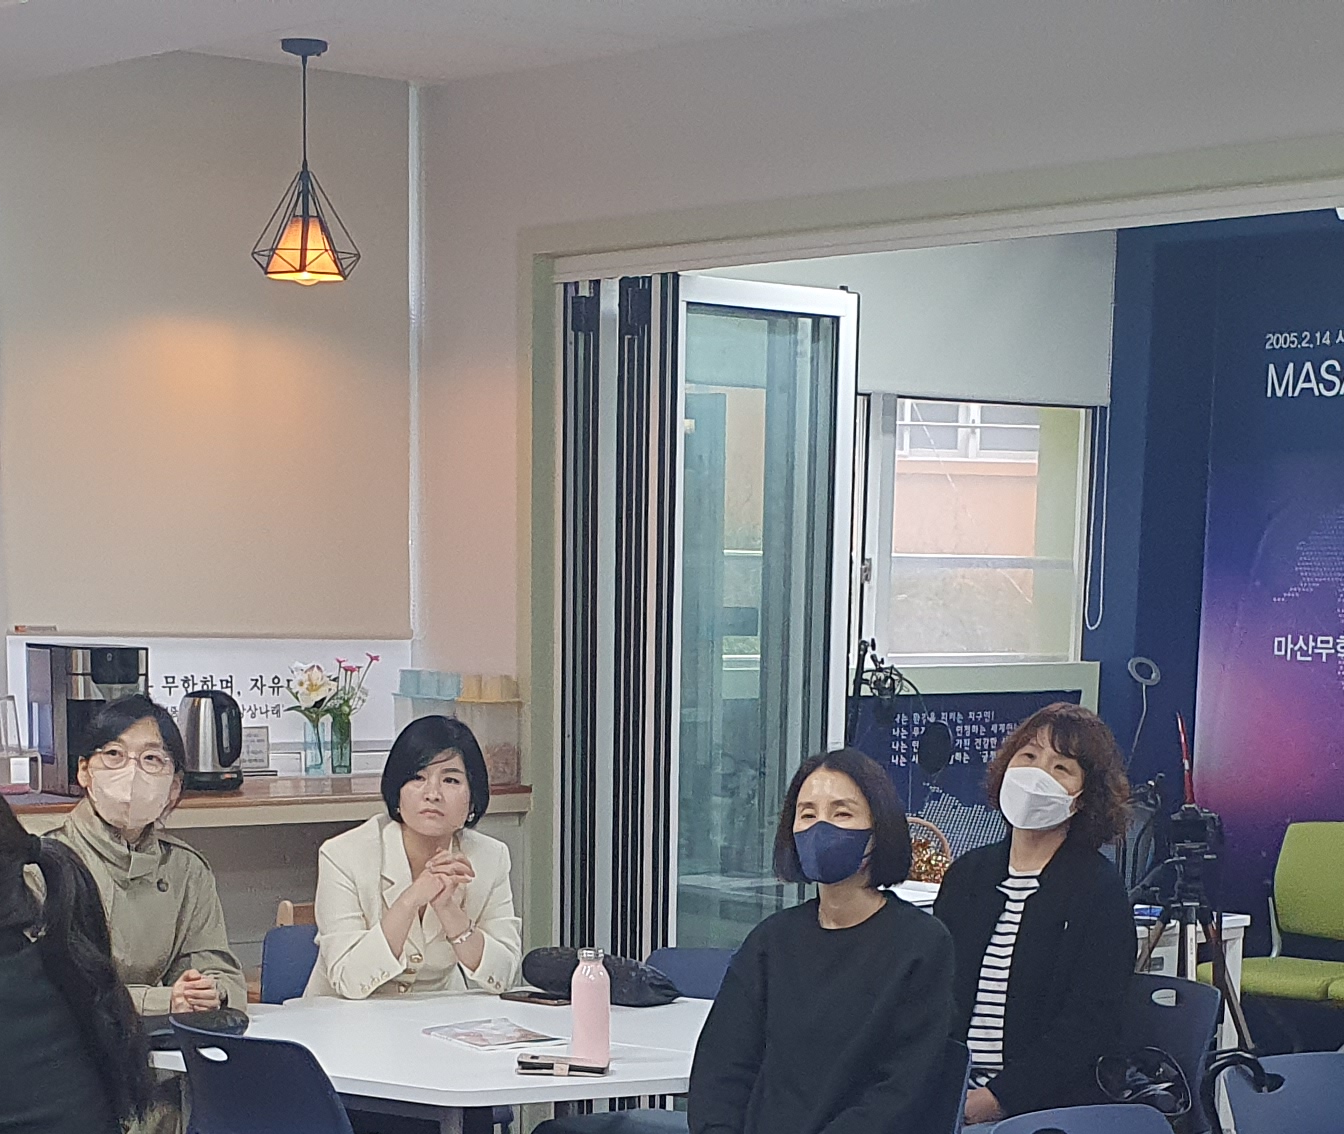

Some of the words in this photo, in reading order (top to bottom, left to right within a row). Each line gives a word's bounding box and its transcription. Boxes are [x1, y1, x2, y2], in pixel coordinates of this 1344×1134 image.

[1265, 330, 1331, 350] 2005.2.14
[892, 726, 909, 739] 나는
[891, 740, 908, 753] 나는
[891, 754, 908, 767] 나는
